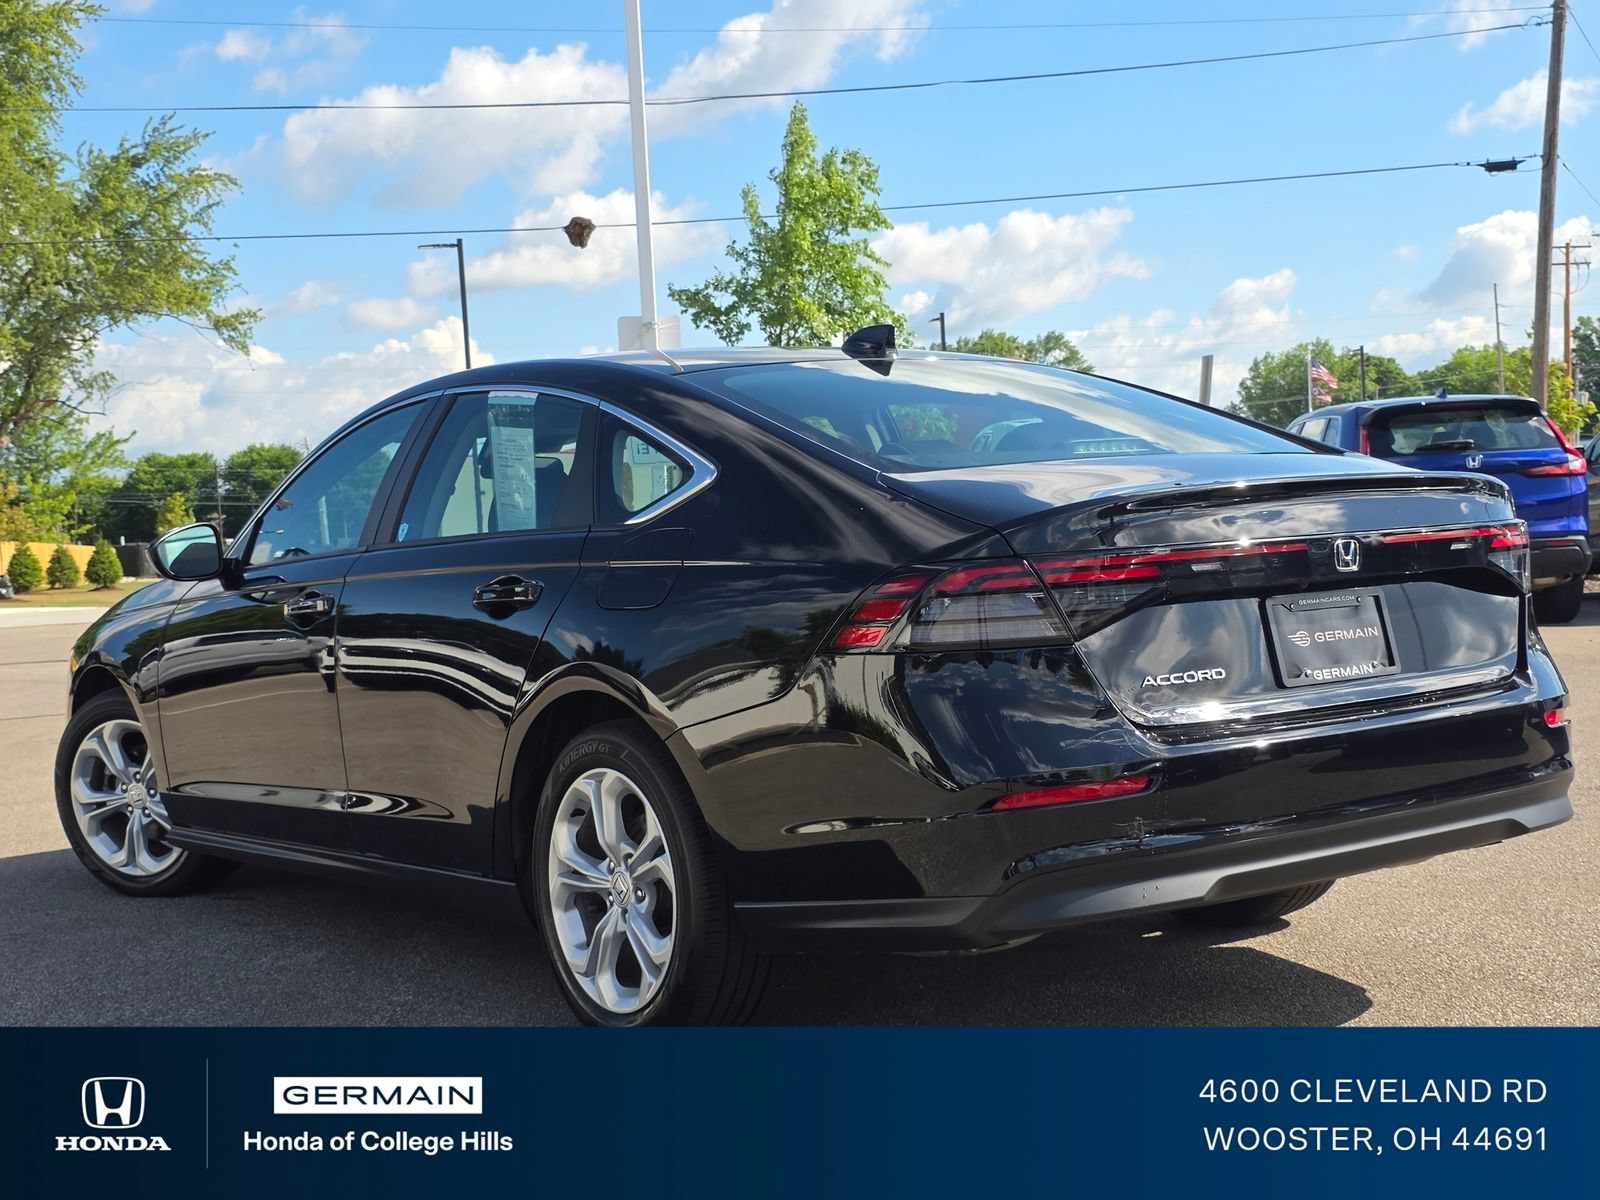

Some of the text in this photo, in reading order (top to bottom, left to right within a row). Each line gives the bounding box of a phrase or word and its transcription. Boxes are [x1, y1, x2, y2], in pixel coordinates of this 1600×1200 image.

[1298, 595, 1355, 606] GERMAINCARS.COM
[1314, 626, 1379, 643] GERMAIN
[1142, 668, 1226, 687] ACCORD
[1313, 663, 1373, 680] GERMAIN
[599, 744, 611, 753] GT
